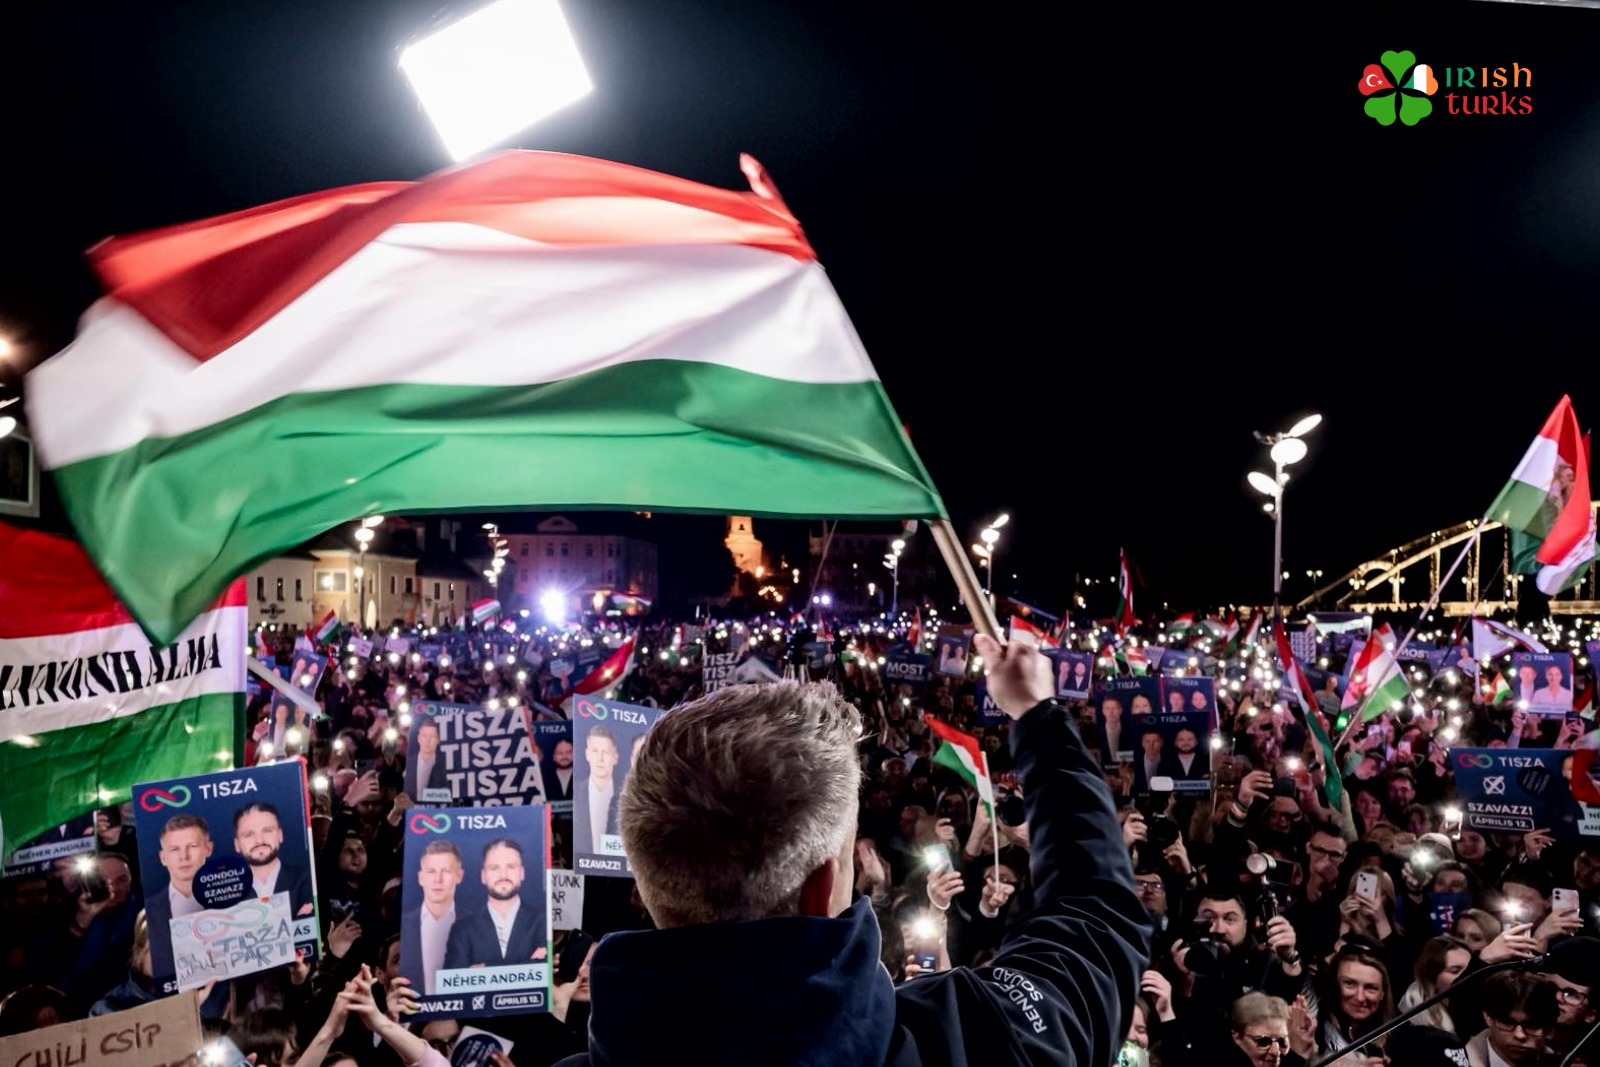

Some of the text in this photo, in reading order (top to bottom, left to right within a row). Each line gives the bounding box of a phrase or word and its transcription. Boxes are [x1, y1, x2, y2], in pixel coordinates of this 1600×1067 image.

[886, 662, 926, 675] MOST
[434, 704, 529, 741] TISZA
[611, 708, 648, 726] TISZA
[1160, 715, 1188, 723] TISZA
[541, 724, 568, 734] TISZA
[440, 735, 540, 770] TISZA
[1498, 756, 1545, 768] TISZA
[446, 760, 547, 798] TISZA
[199, 778, 258, 800] TISZA
[1467, 802, 1534, 816] SZAVAZZ!
[457, 814, 507, 830] TISZA
[578, 858, 621, 870] SZAVAZZ!
[200, 867, 245, 884] GONDOLJ
[204, 882, 244, 899] SZAVAZZ
[442, 969, 543, 988] NÉHER ANDRÁS
[992, 967, 1044, 1002] SQUAD
